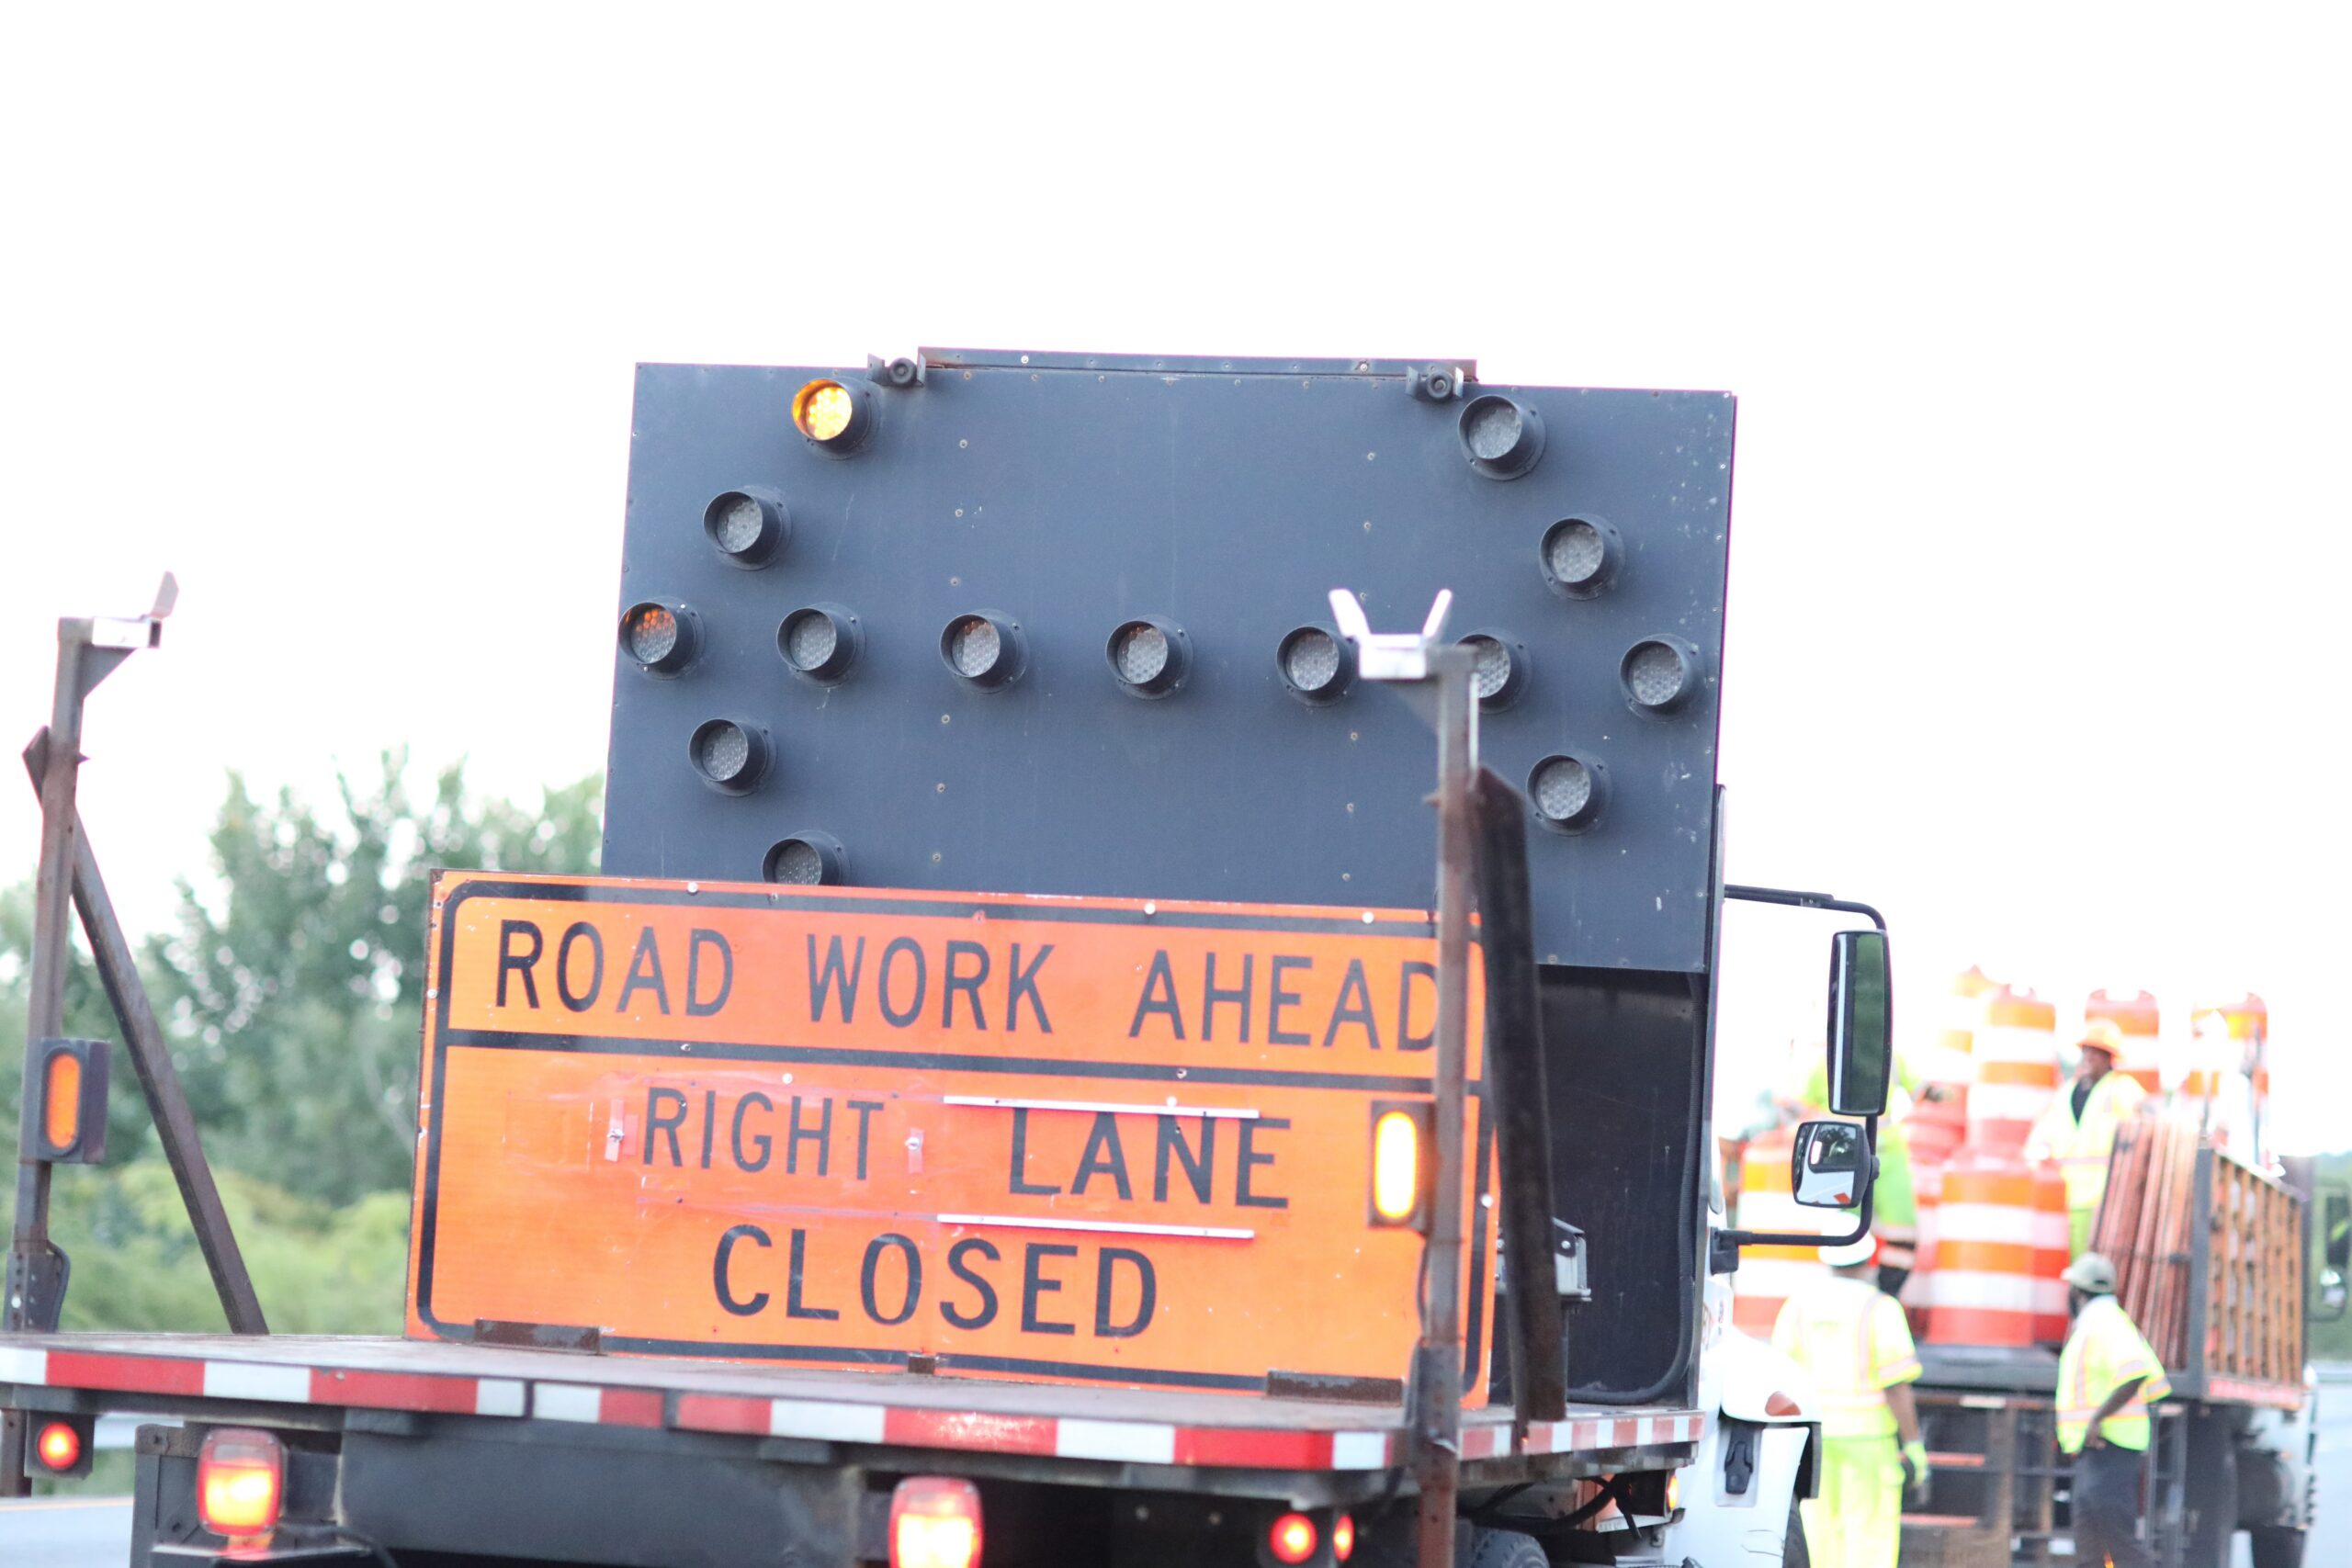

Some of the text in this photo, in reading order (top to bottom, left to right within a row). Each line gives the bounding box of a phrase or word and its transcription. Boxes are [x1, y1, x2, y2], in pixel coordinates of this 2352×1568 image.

[496, 919, 1439, 1052] ROAD WORK AHEAD
[643, 1088, 1291, 1209] RIGHT LANE
[713, 1224, 1157, 1338] CLOSED
